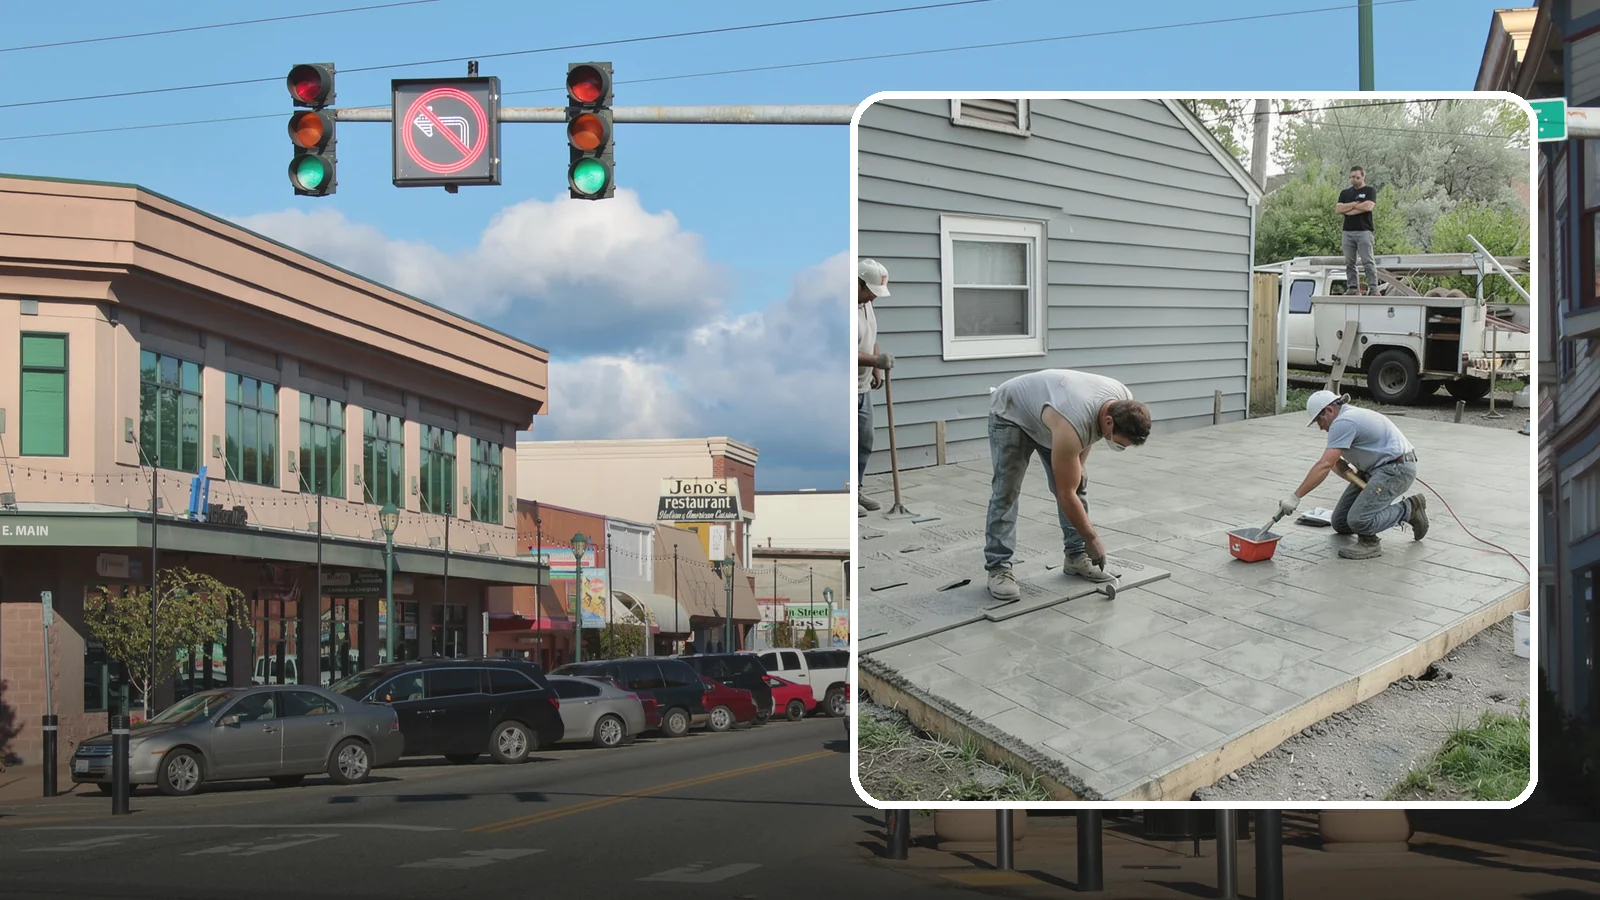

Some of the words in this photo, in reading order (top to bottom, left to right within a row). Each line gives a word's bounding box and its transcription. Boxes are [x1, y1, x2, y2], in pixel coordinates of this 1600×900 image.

[669, 480, 727, 494] Jeno's
[665, 496, 731, 509] restaurant
[686, 509, 714, 520] American
[715, 509, 737, 520] Cuisine
[2, 525, 13, 536] E.
[15, 525, 49, 536] MAIN
[797, 607, 829, 616] Street
[790, 619, 823, 627] lass
